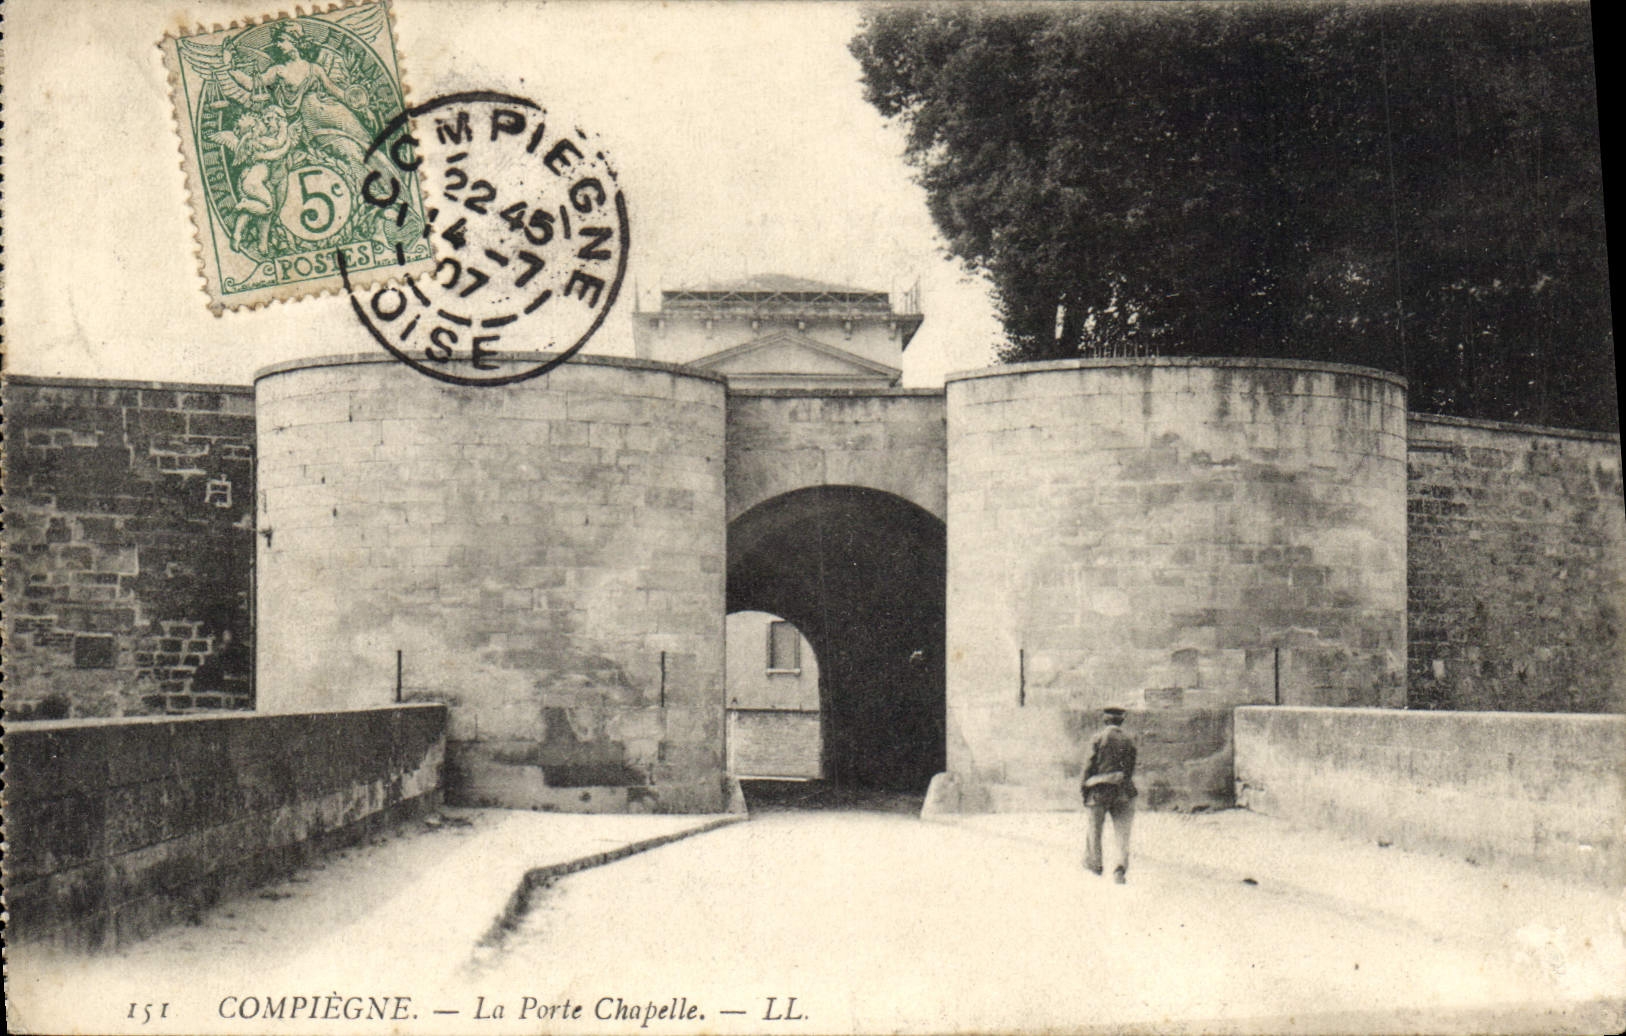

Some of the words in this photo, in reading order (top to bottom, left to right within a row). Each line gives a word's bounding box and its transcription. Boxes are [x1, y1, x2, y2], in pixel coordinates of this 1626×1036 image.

[443, 167, 497, 215] 22
[278, 244, 371, 280] POSTES
[371, 287, 501, 370] OISE
